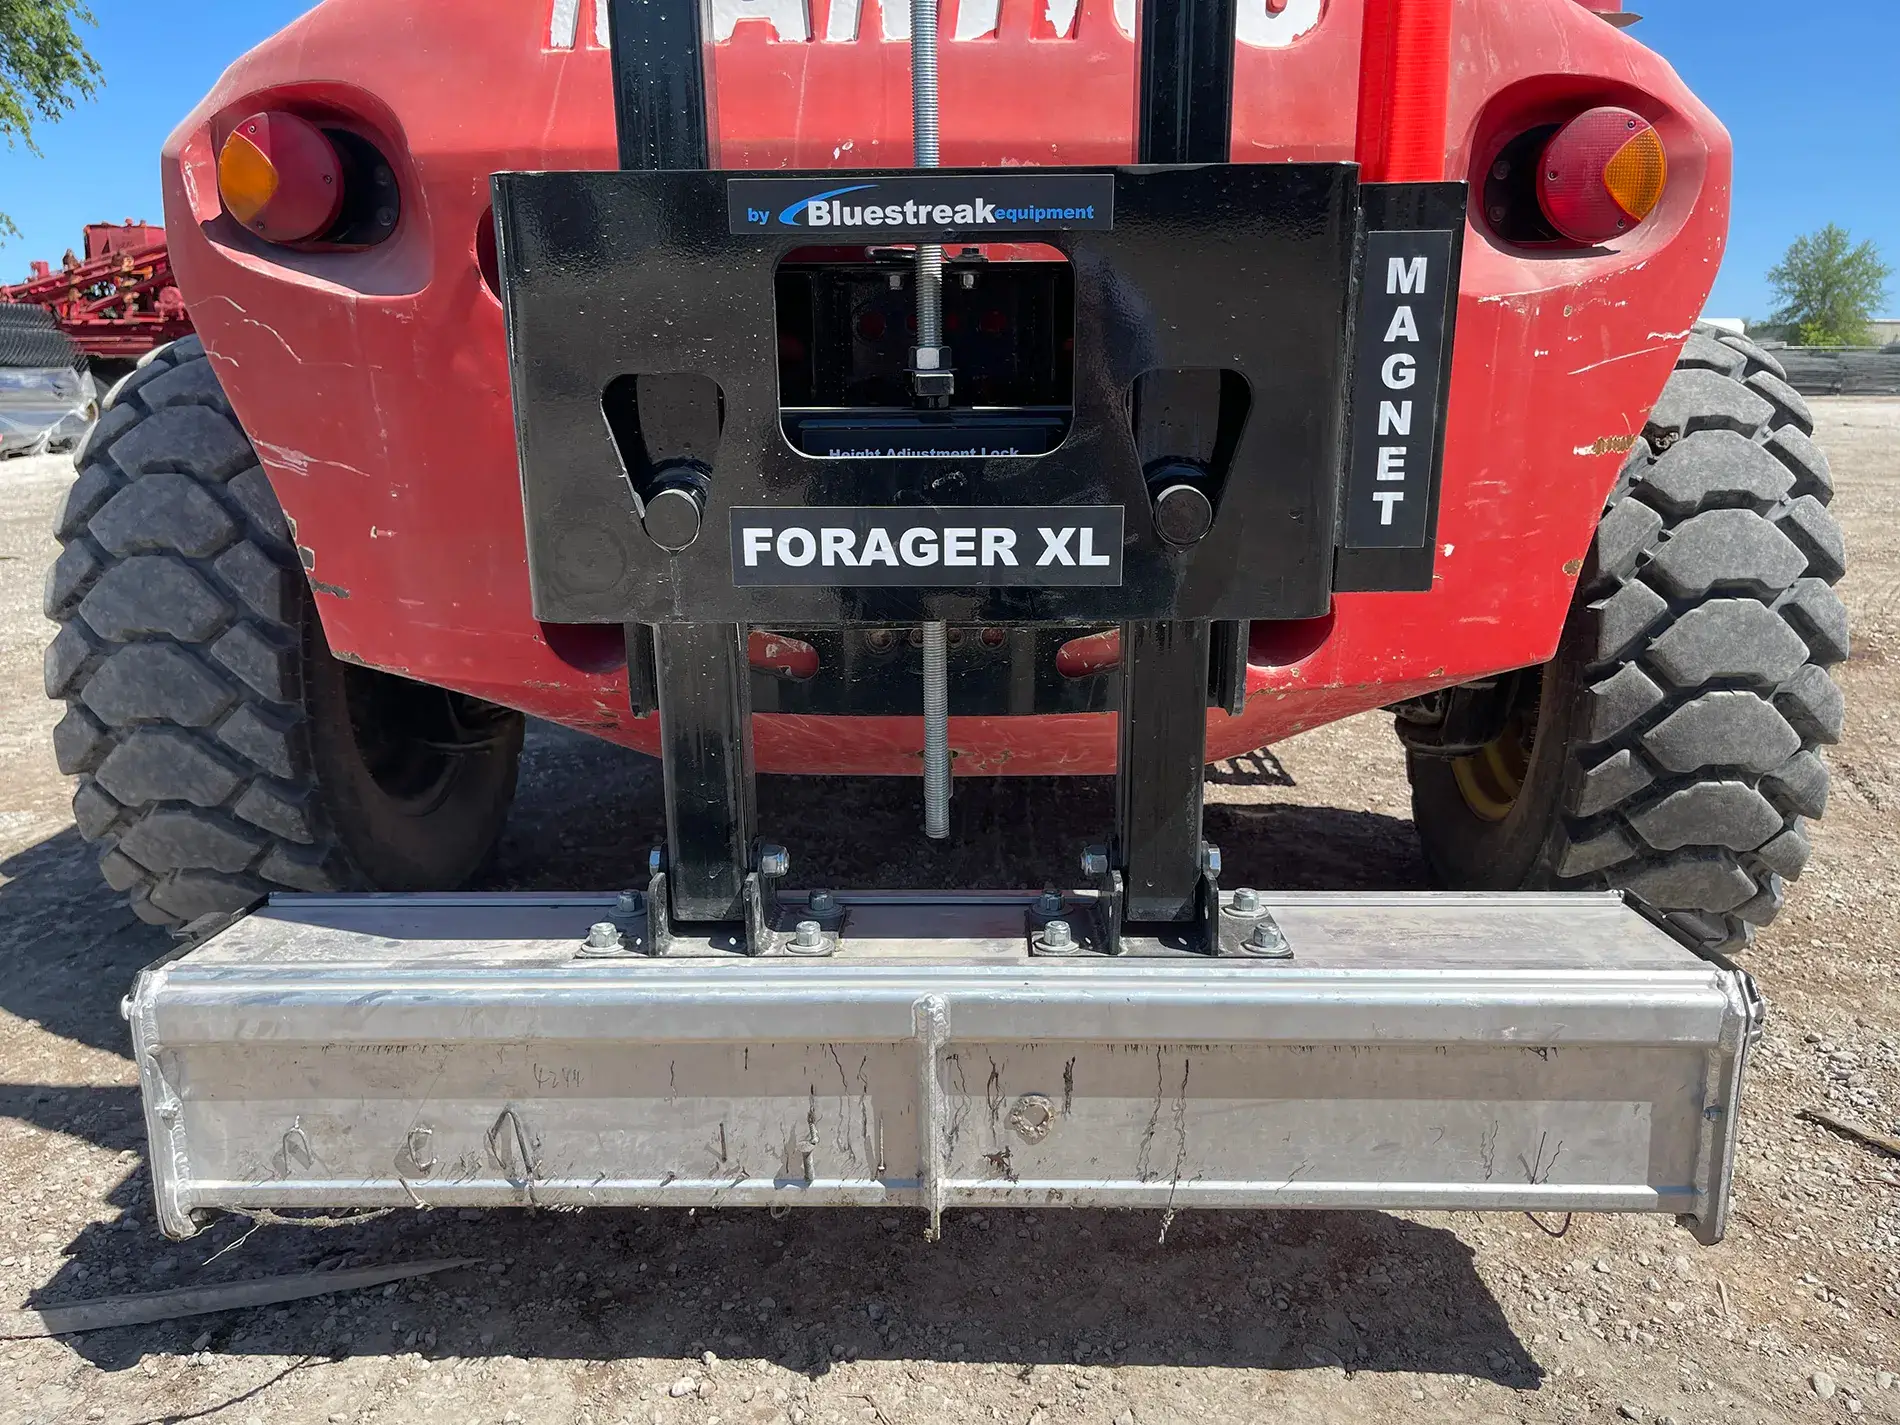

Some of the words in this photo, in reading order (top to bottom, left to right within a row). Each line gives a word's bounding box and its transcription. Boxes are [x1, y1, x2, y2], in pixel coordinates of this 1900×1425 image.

[747, 207, 770, 225] by
[807, 198, 997, 227] Bluestreak
[995, 205, 1095, 221] equipment
[1372, 257, 1428, 525] MAGNET
[742, 527, 1019, 567] FORAGER
[1035, 527, 1110, 566] XL
